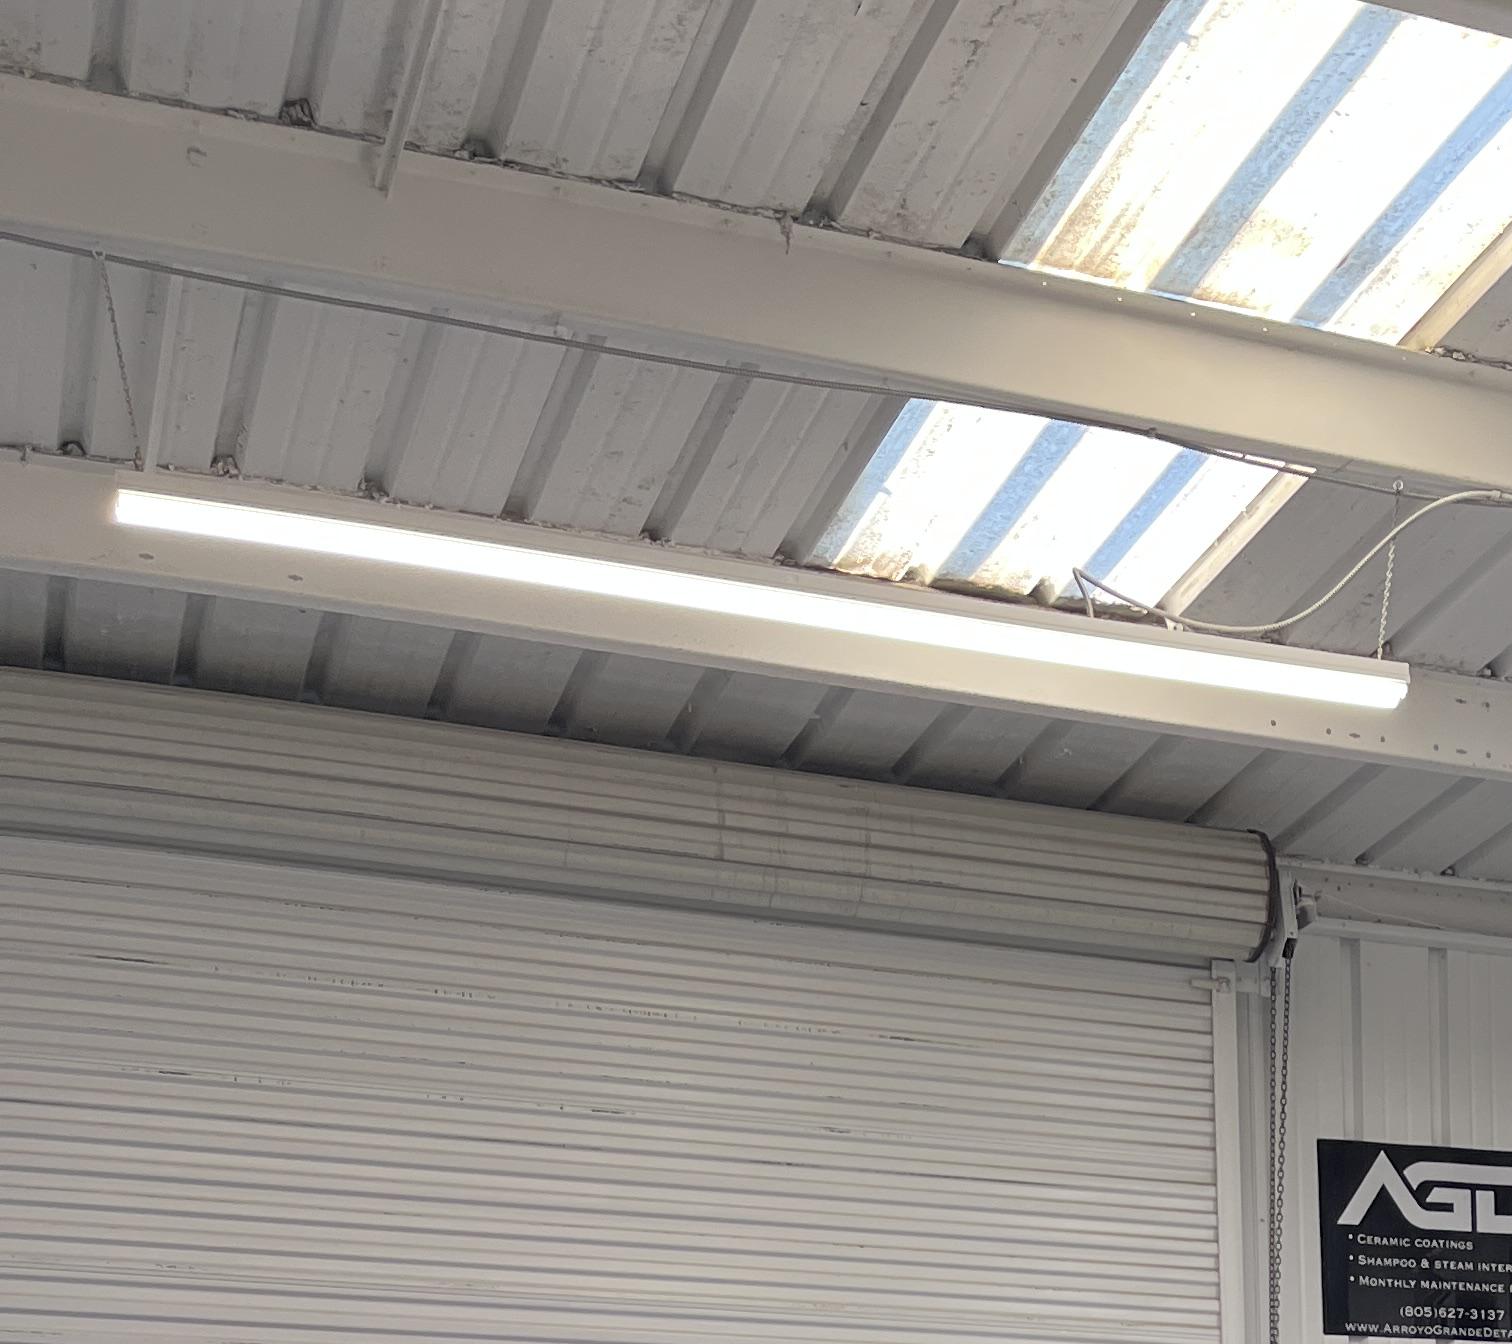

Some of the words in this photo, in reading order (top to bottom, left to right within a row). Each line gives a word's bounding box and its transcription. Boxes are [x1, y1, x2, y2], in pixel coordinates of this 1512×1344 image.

[1357, 1233, 1411, 1248] CERAMIC
[1414, 1238, 1474, 1251] COATINGS
[1358, 1254, 1417, 1269] SHAMPOO
[1420, 1258, 1430, 1269] &
[1434, 1260, 1474, 1271] STEAM
[1359, 1275, 1417, 1289] MONTHLY
[1420, 1279, 1506, 1294] MAINTENANCE
[1400, 1305, 1505, 1321] (805)627-3137
